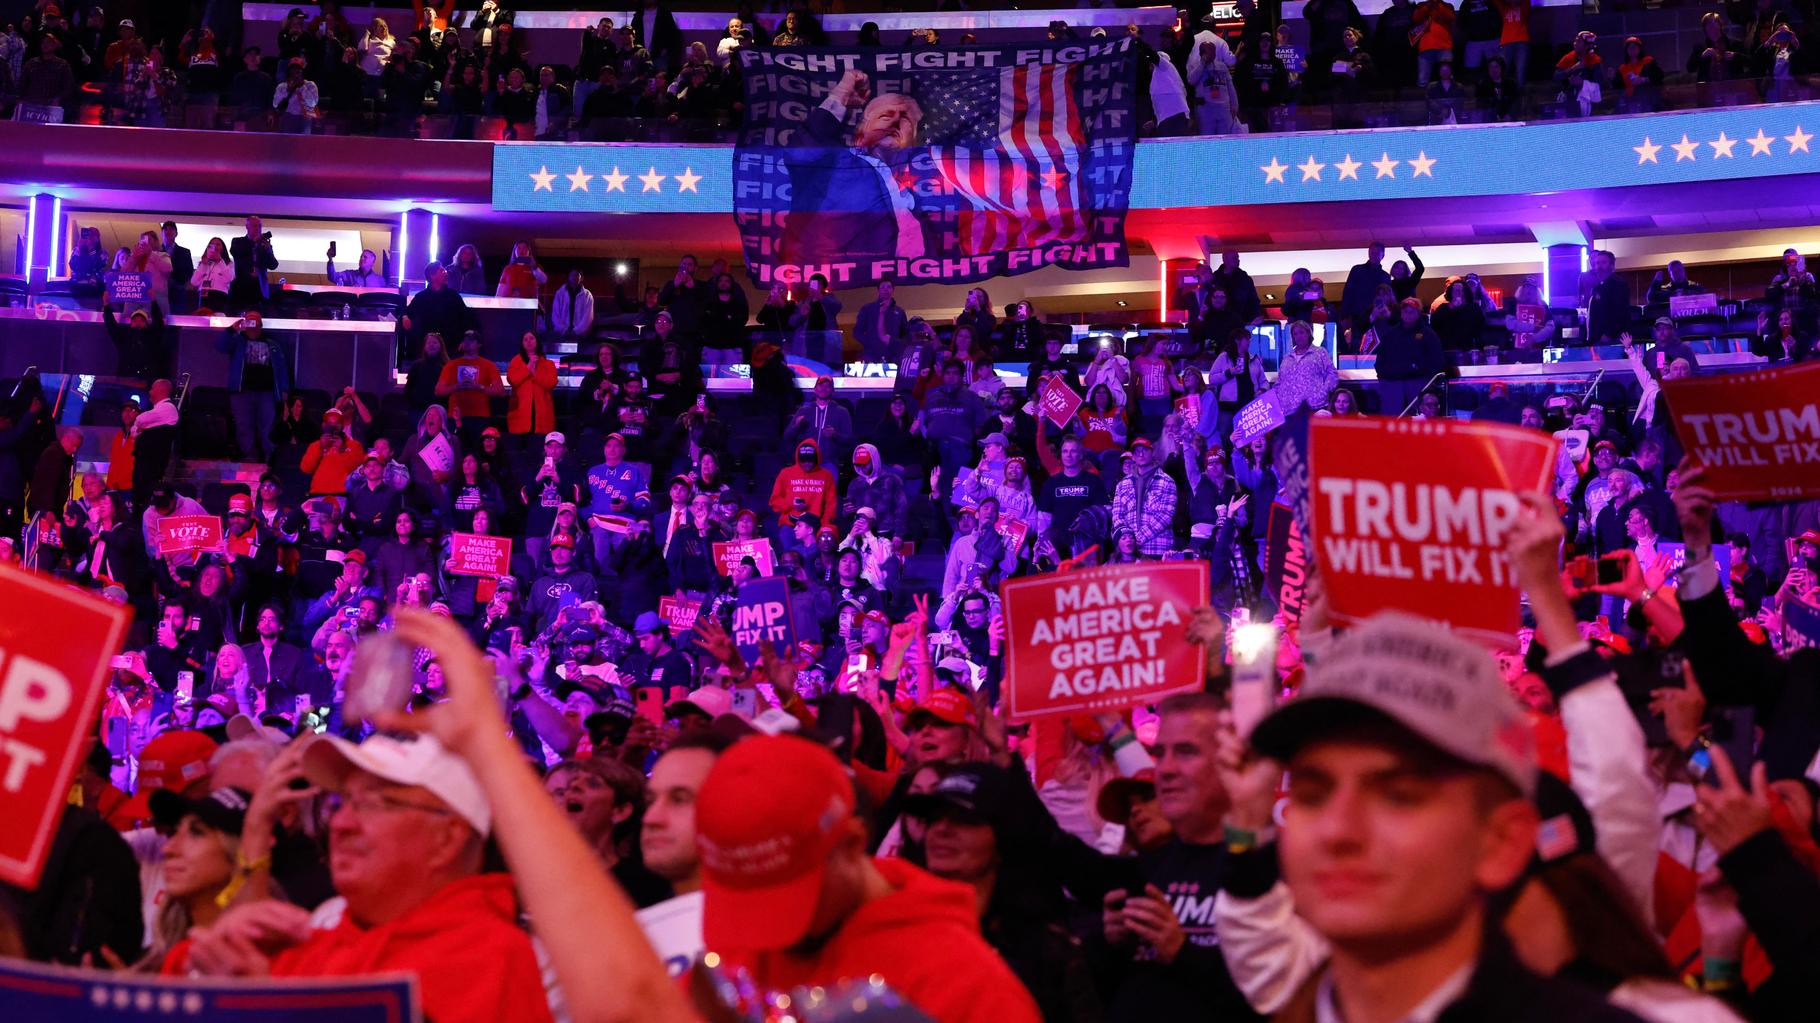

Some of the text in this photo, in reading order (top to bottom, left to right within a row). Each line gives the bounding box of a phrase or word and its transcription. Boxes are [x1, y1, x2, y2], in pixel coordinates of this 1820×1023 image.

[740, 37, 1133, 72] FIGHT FIGHT FIGHT
[750, 73, 838, 97] FIGH
[871, 255, 995, 280] FIGHT
[1008, 242, 1121, 269] FIGHT
[1046, 388, 1069, 413] VOTE
[1241, 399, 1264, 417] MAKE
[1237, 402, 1273, 428] AMERICA
[1242, 411, 1269, 430] GREAT
[1682, 404, 1820, 445] TRUM
[1245, 417, 1273, 438] AGAIN!
[1694, 447, 1769, 467] WILL
[1318, 476, 1522, 548] TRUMP
[169, 525, 210, 539] VOTE
[468, 537, 497, 548] MAKE
[459, 545, 504, 558] AMERICA
[464, 553, 497, 565] GREAT
[726, 544, 754, 554] MAKE
[1323, 535, 1414, 579] WILL
[1420, 544, 1483, 585] FIX
[462, 561, 498, 573] AGAIN!
[1054, 575, 1150, 613] MAKE
[732, 601, 785, 632] UMP
[1030, 600, 1181, 646] AMERICA
[767, 625, 787, 642] IT
[1050, 631, 1162, 670] GREAT
[1049, 659, 1166, 700] AGAIN!
